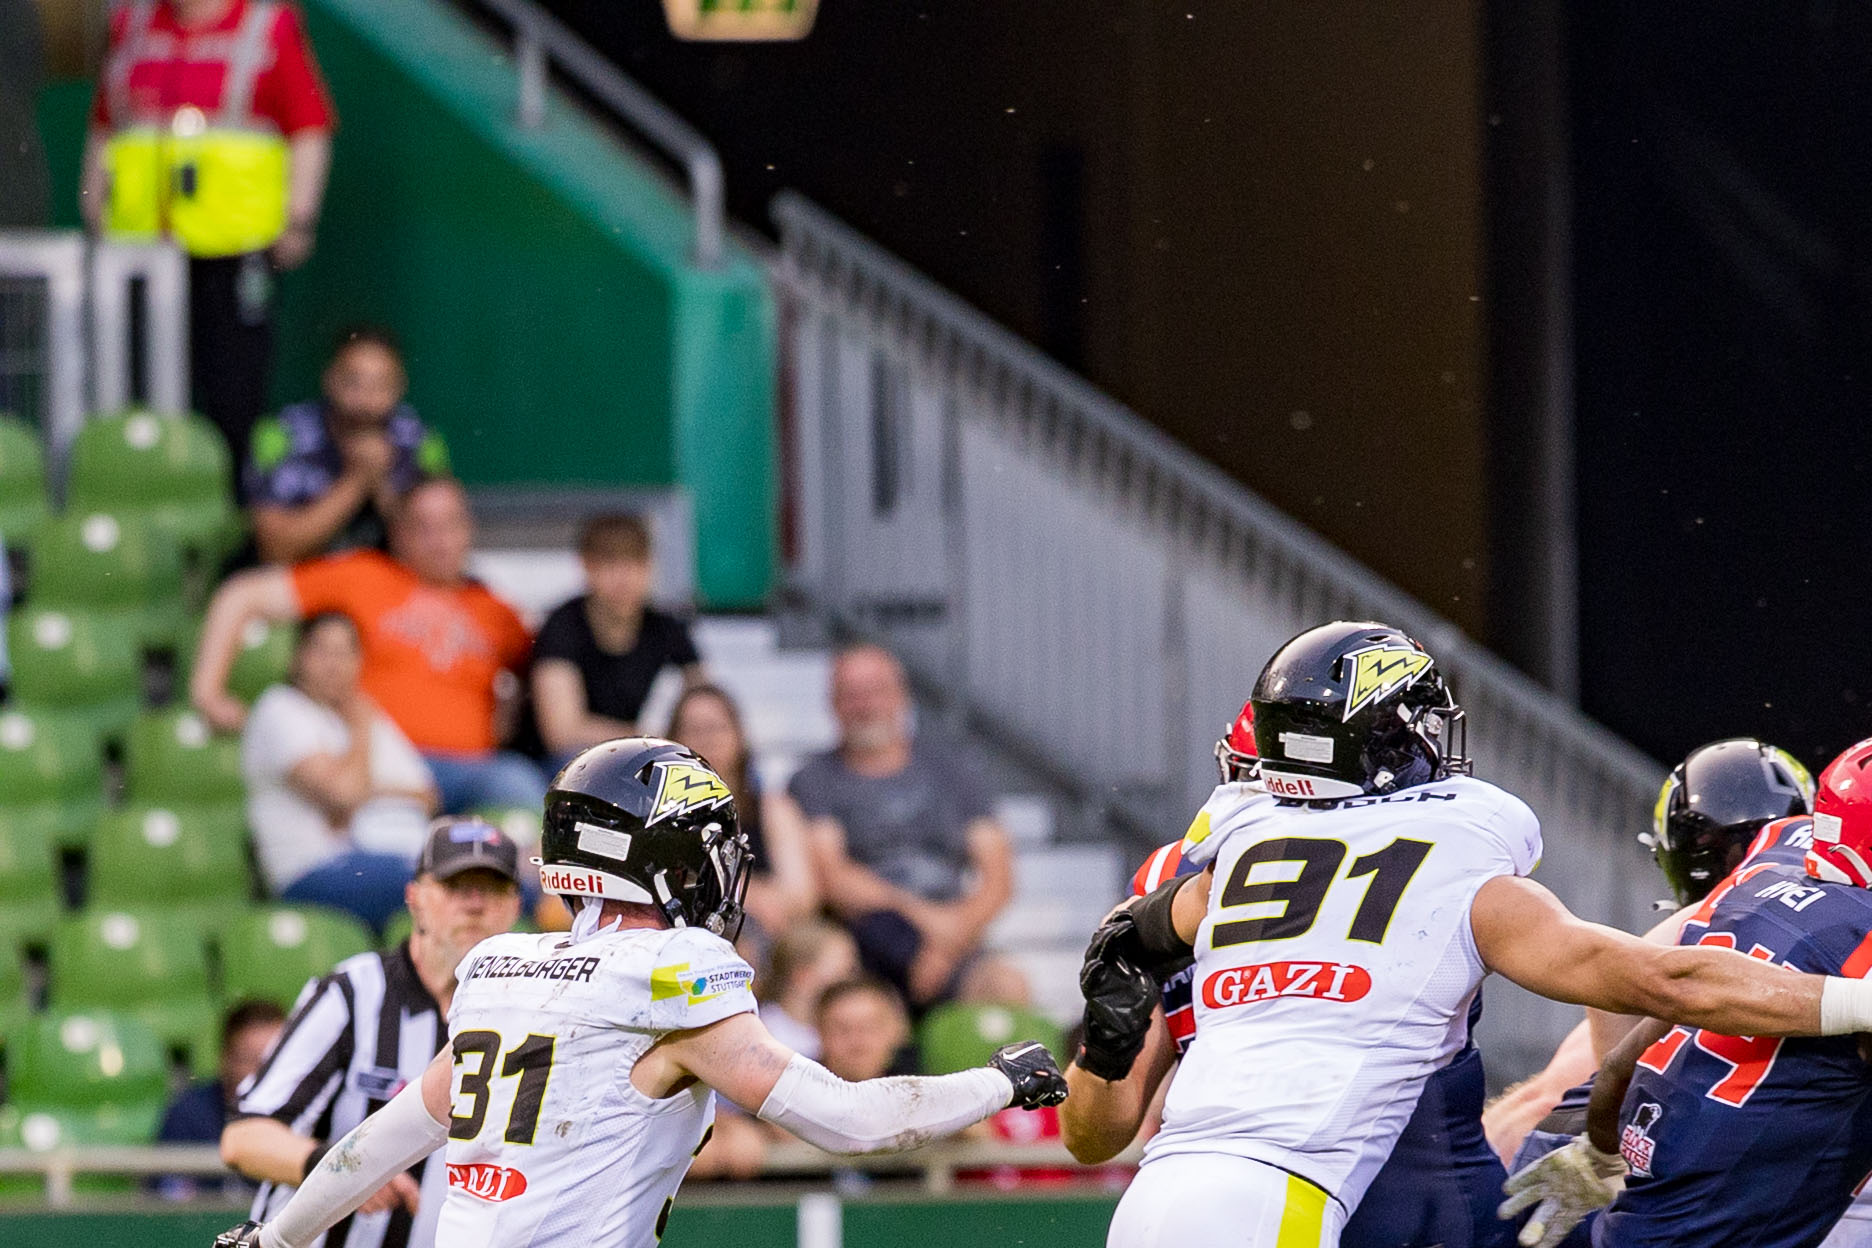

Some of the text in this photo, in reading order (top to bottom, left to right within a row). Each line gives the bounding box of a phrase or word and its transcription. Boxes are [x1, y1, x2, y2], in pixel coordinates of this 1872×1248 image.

[1211, 836, 1436, 950] 91
[463, 955, 601, 984] WENZELBURGER
[447, 1029, 557, 1146] 31
